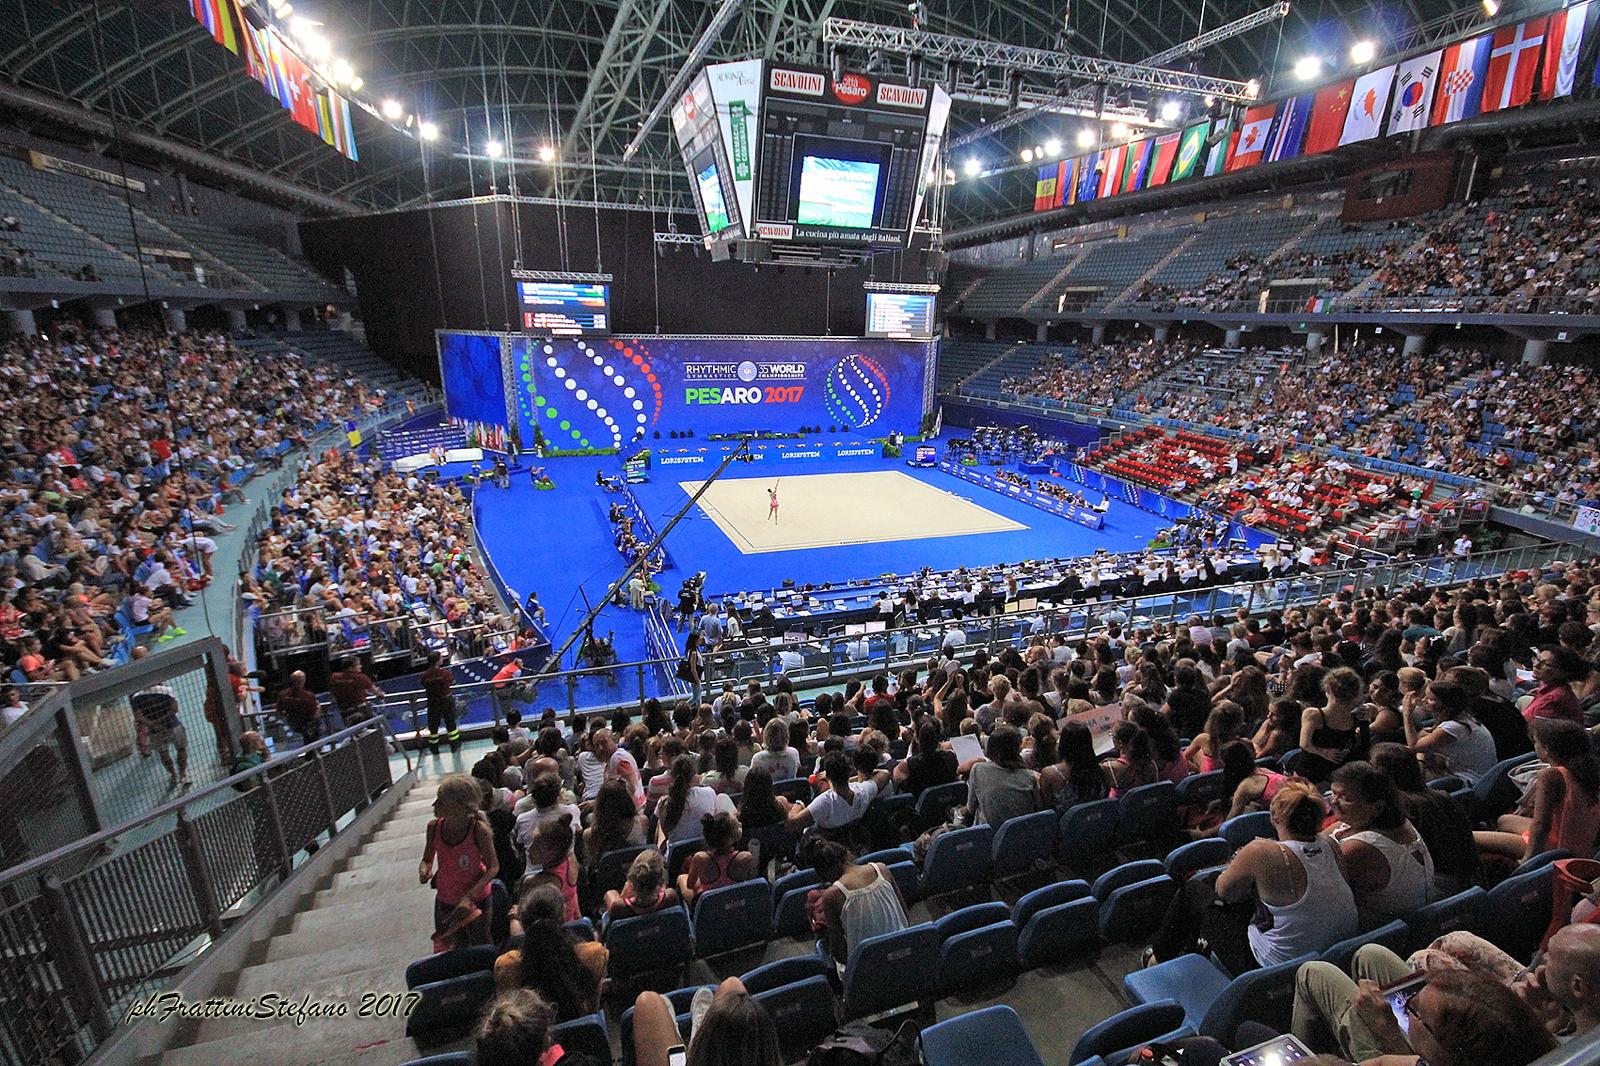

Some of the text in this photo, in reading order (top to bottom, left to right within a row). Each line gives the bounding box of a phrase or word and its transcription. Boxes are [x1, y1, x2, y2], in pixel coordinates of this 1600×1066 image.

[774, 72, 822, 91] SCAVOLINI
[835, 83, 867, 96] Pesaro
[880, 88, 925, 105] SCAVOLINI
[796, 228, 805, 237] La
[806, 230, 828, 239] cucina
[840, 232, 860, 240] amata
[686, 365, 736, 374] RHYTHMIC
[770, 364, 805, 373] WORLD
[685, 386, 804, 404] PESARO 2017
[660, 456, 704, 465] LORISYSTEM
[781, 451, 821, 459] LORISYSTEM
